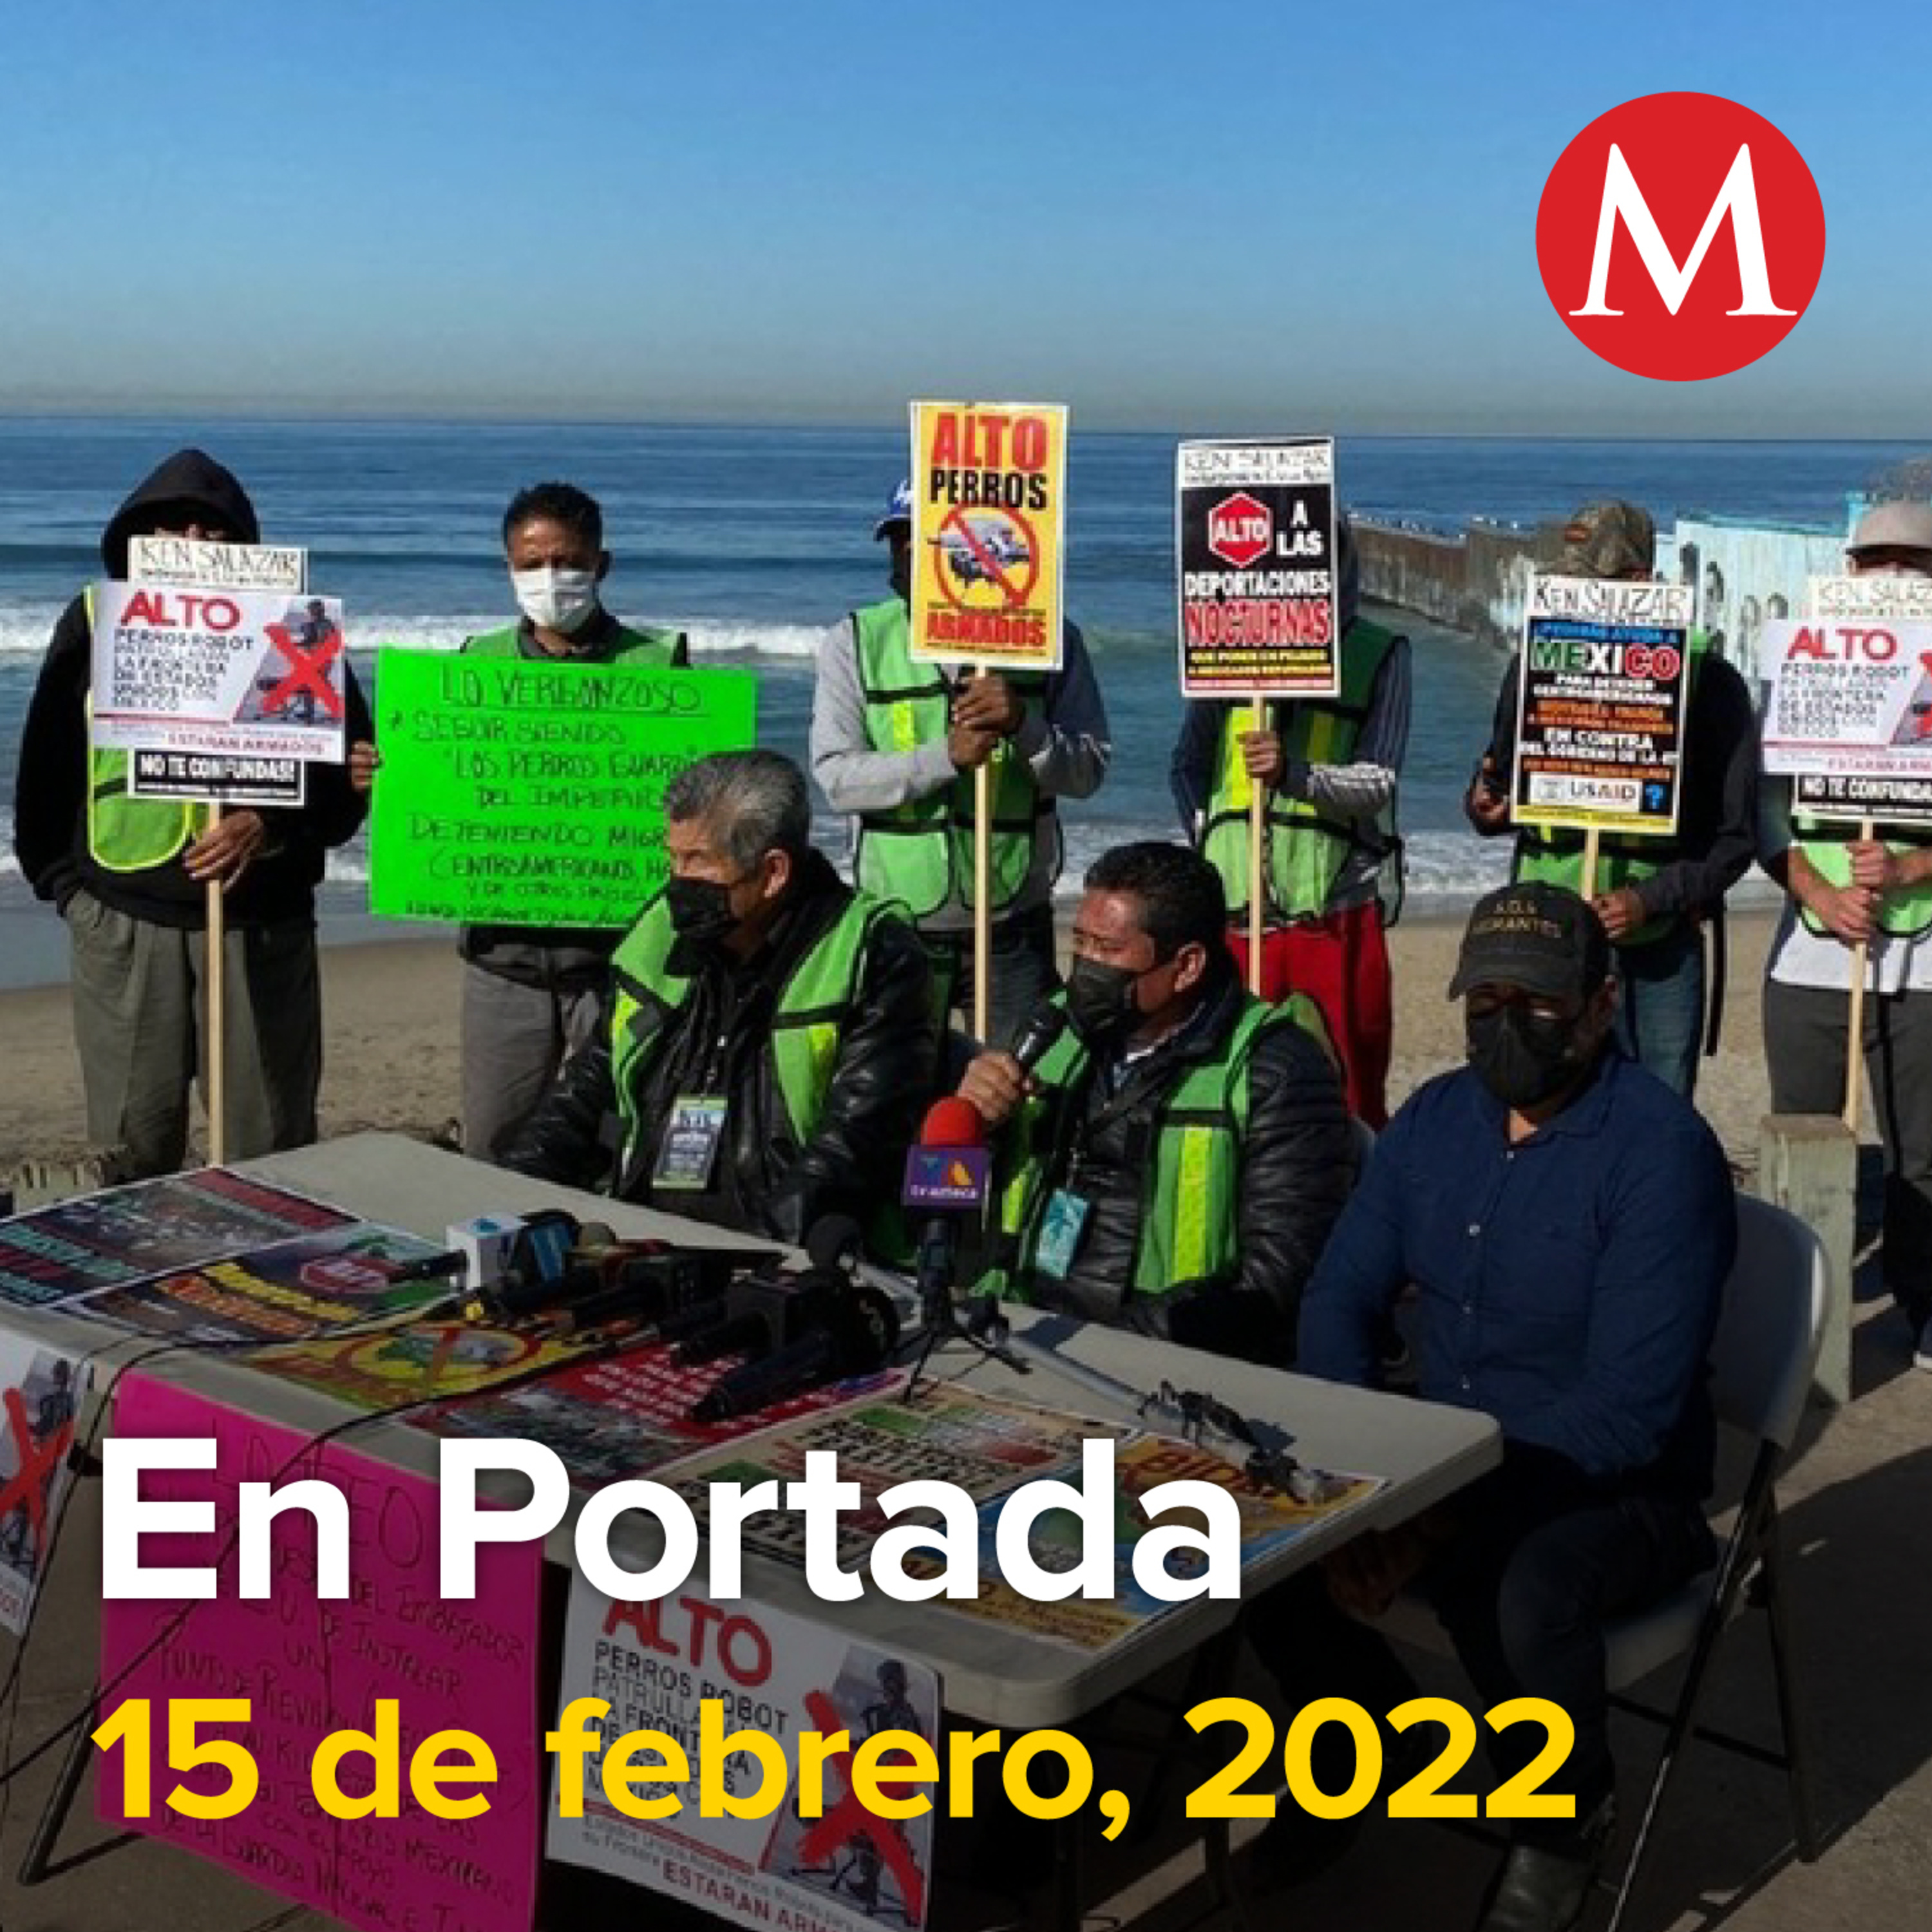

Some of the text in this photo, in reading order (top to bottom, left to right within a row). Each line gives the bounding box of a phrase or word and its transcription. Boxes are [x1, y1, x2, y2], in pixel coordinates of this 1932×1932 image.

[932, 412, 1048, 473] ALTO
[931, 470, 1047, 510] PERROS
[1214, 517, 1269, 542] ALTO
[1291, 500, 1309, 527] A
[1276, 531, 1324, 556] LAS
[1185, 571, 1331, 597] DEPORTACIONES
[120, 591, 242, 631] ALTO
[1185, 599, 1331, 647] NOCTURNAS
[115, 629, 187, 647] PERROS
[1787, 626, 1898, 663] ALTO
[1530, 638, 1681, 681] MEXICO
[140, 755, 165, 775] NO
[603, 1596, 773, 1689] ALTO
[593, 1642, 695, 1700] PERROS
[663, 1855, 772, 1922] ESTARAN
